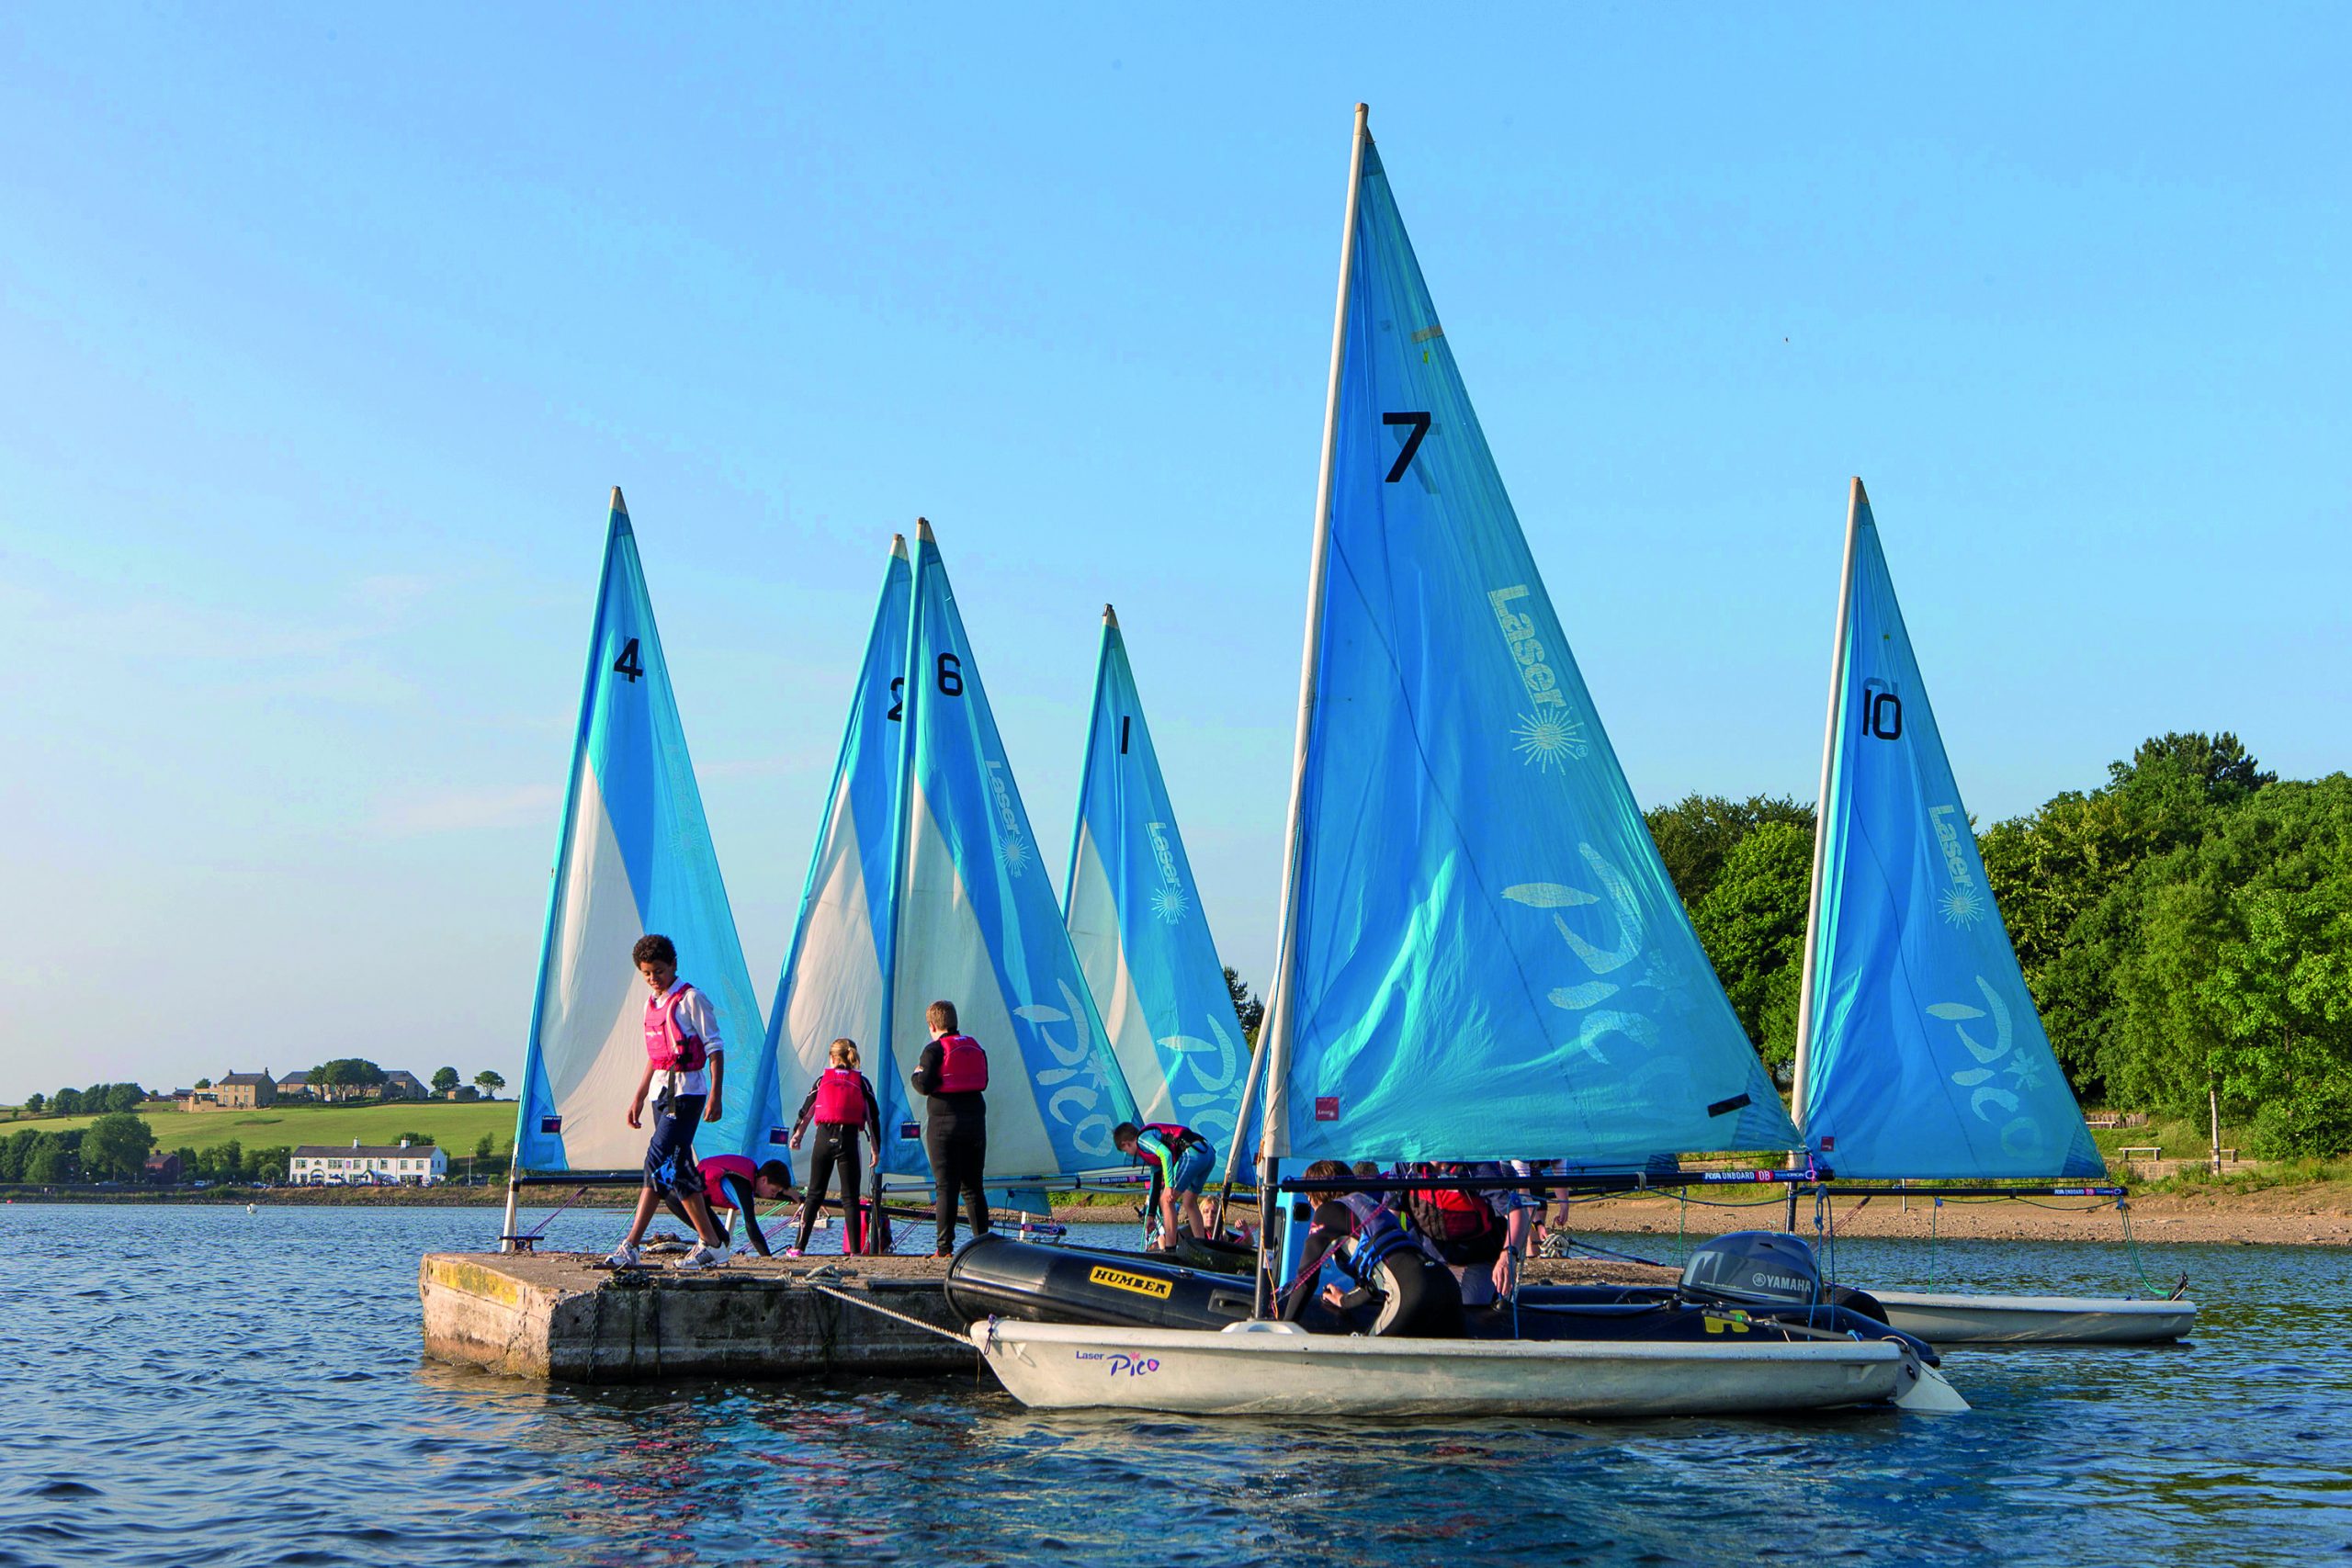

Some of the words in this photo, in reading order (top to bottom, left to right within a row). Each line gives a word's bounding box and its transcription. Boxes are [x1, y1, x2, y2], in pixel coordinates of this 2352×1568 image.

[1383, 412, 1431, 483] 7
[614, 637, 643, 683] 4
[1490, 584, 1566, 708] Laser
[887, 677, 905, 722] 2
[937, 652, 964, 697] 6
[1862, 688, 1903, 740] 10
[985, 761, 1020, 835] Laser
[1148, 822, 1182, 887] Laser
[1928, 804, 1974, 887] Laser
[1012, 977, 1115, 1156] Pico
[1093, 1269, 1167, 1294] HUMBER
[1767, 1275, 1812, 1292] YAMAHA
[1076, 1350, 1105, 1360] Laser
[1106, 1354, 1160, 1376] Pico
